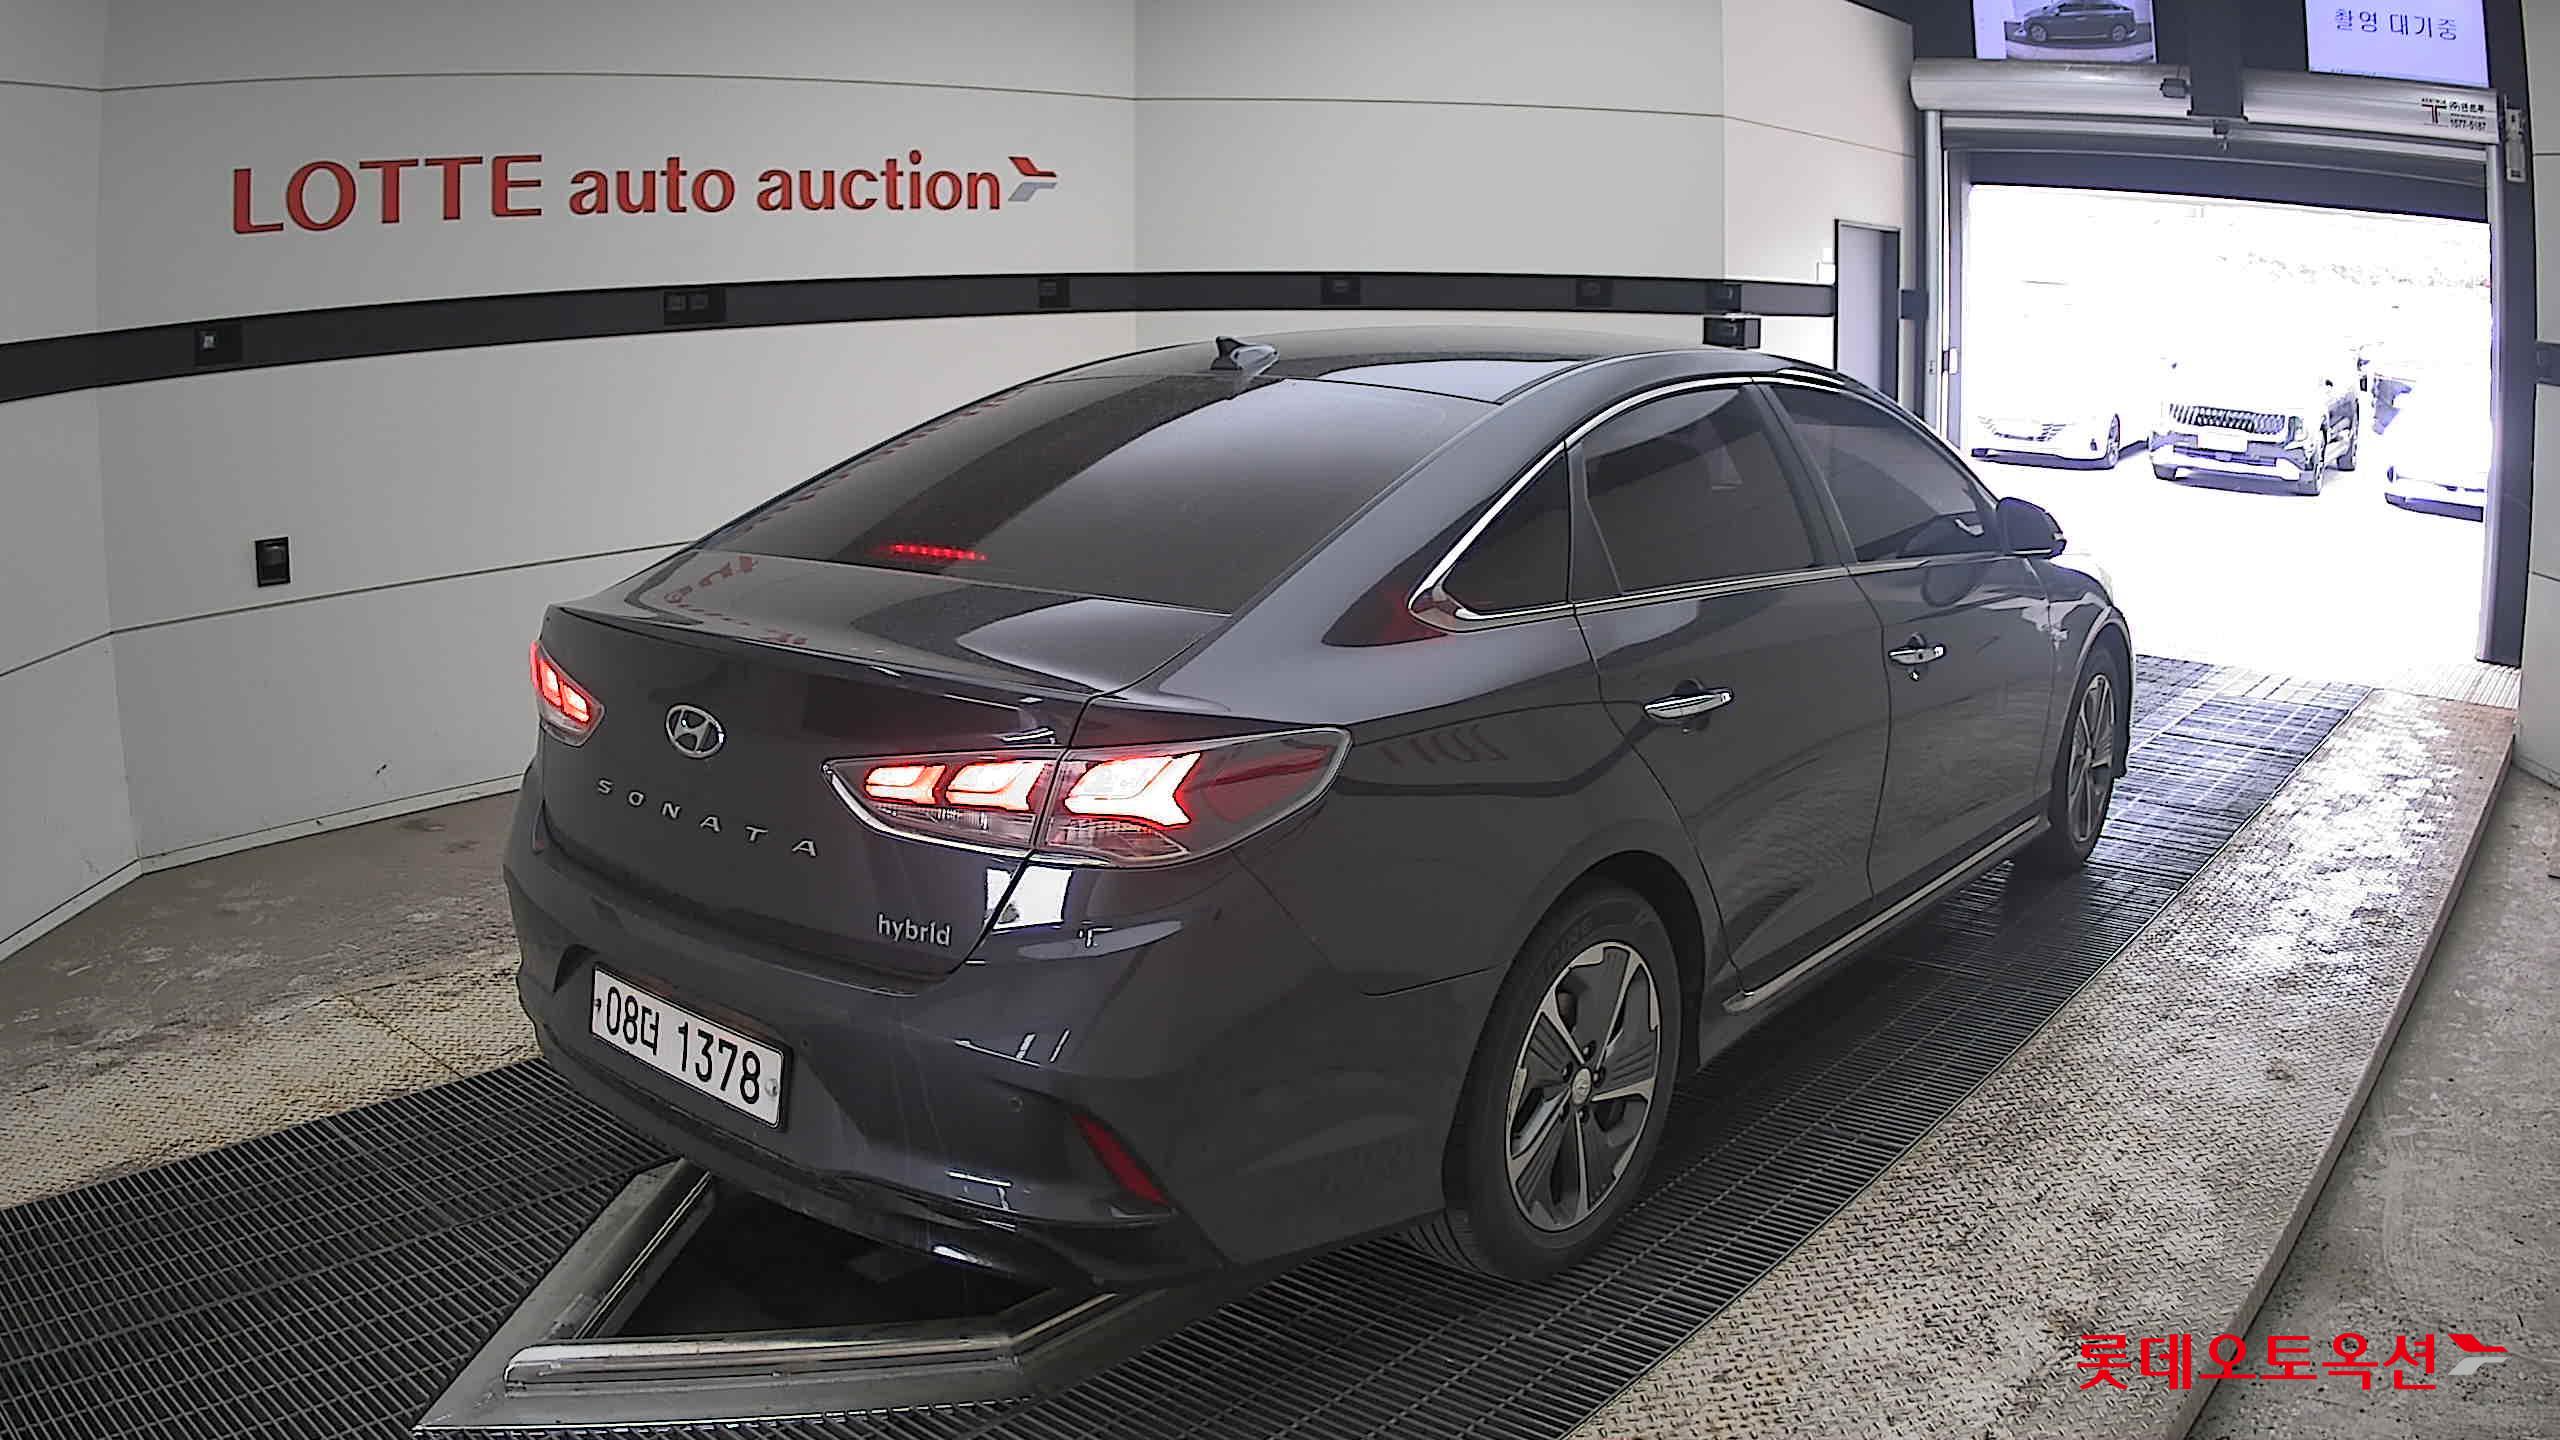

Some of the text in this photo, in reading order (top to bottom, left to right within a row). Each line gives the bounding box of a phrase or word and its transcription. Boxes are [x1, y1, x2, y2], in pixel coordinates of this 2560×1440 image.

[2335, 8, 2457, 41] 촬영 대기중
[233, 150, 1002, 234] LOTTE auto auction
[597, 779, 817, 857] SONATA
[876, 913, 952, 947] hybrid
[606, 986, 761, 1104] 08더 1378
